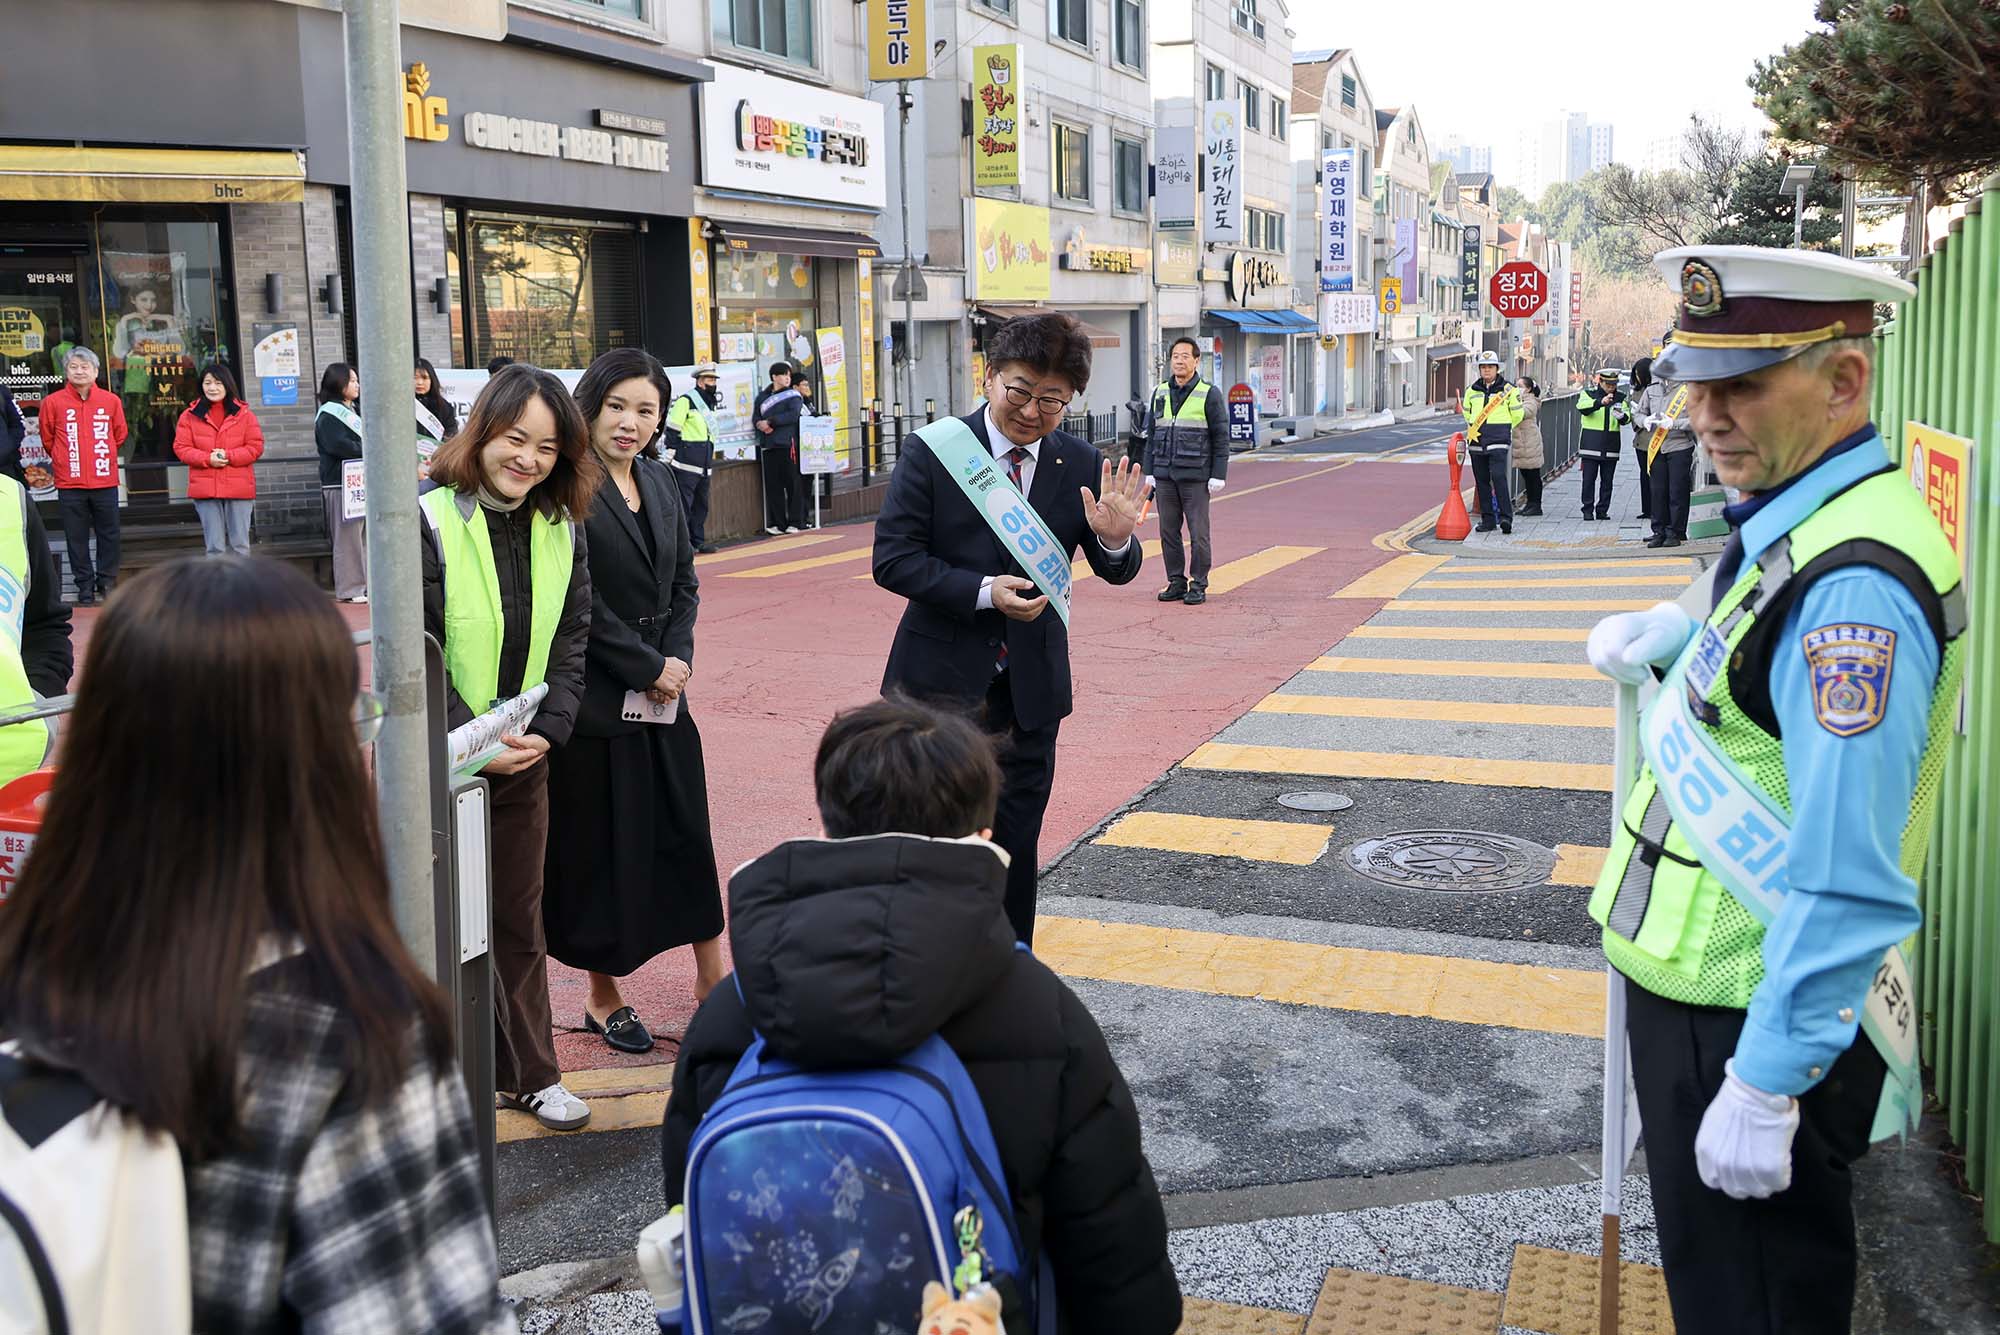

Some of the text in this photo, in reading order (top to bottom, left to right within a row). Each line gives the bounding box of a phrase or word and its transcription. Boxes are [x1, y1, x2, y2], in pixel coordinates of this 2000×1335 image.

[401, 71, 449, 142] hc
[1158, 156, 1187, 168] 조이스
[1325, 159, 1351, 173] 송촌
[1157, 169, 1193, 185] 감성미술
[213, 183, 244, 198] bhc
[1212, 164, 1235, 230] 태권도
[1328, 176, 1346, 262] 영재학원
[26, 273, 74, 284] 일반음식점
[1498, 271, 1538, 292] 정지
[1499, 294, 1540, 311] STOP
[143, 343, 182, 353] CHICKEN
[719, 337, 753, 354] OPEN
[144, 354, 184, 364] BEER
[10, 364, 31, 375] bhc
[145, 366, 184, 376] PLATE
[66, 408, 77, 421] 2
[1233, 403, 1250, 422] 책
[1230, 423, 1253, 439] 문구
[93, 421, 110, 477] 김수연
[1000, 504, 1048, 555] 아이
[1659, 718, 1729, 816] 아이
